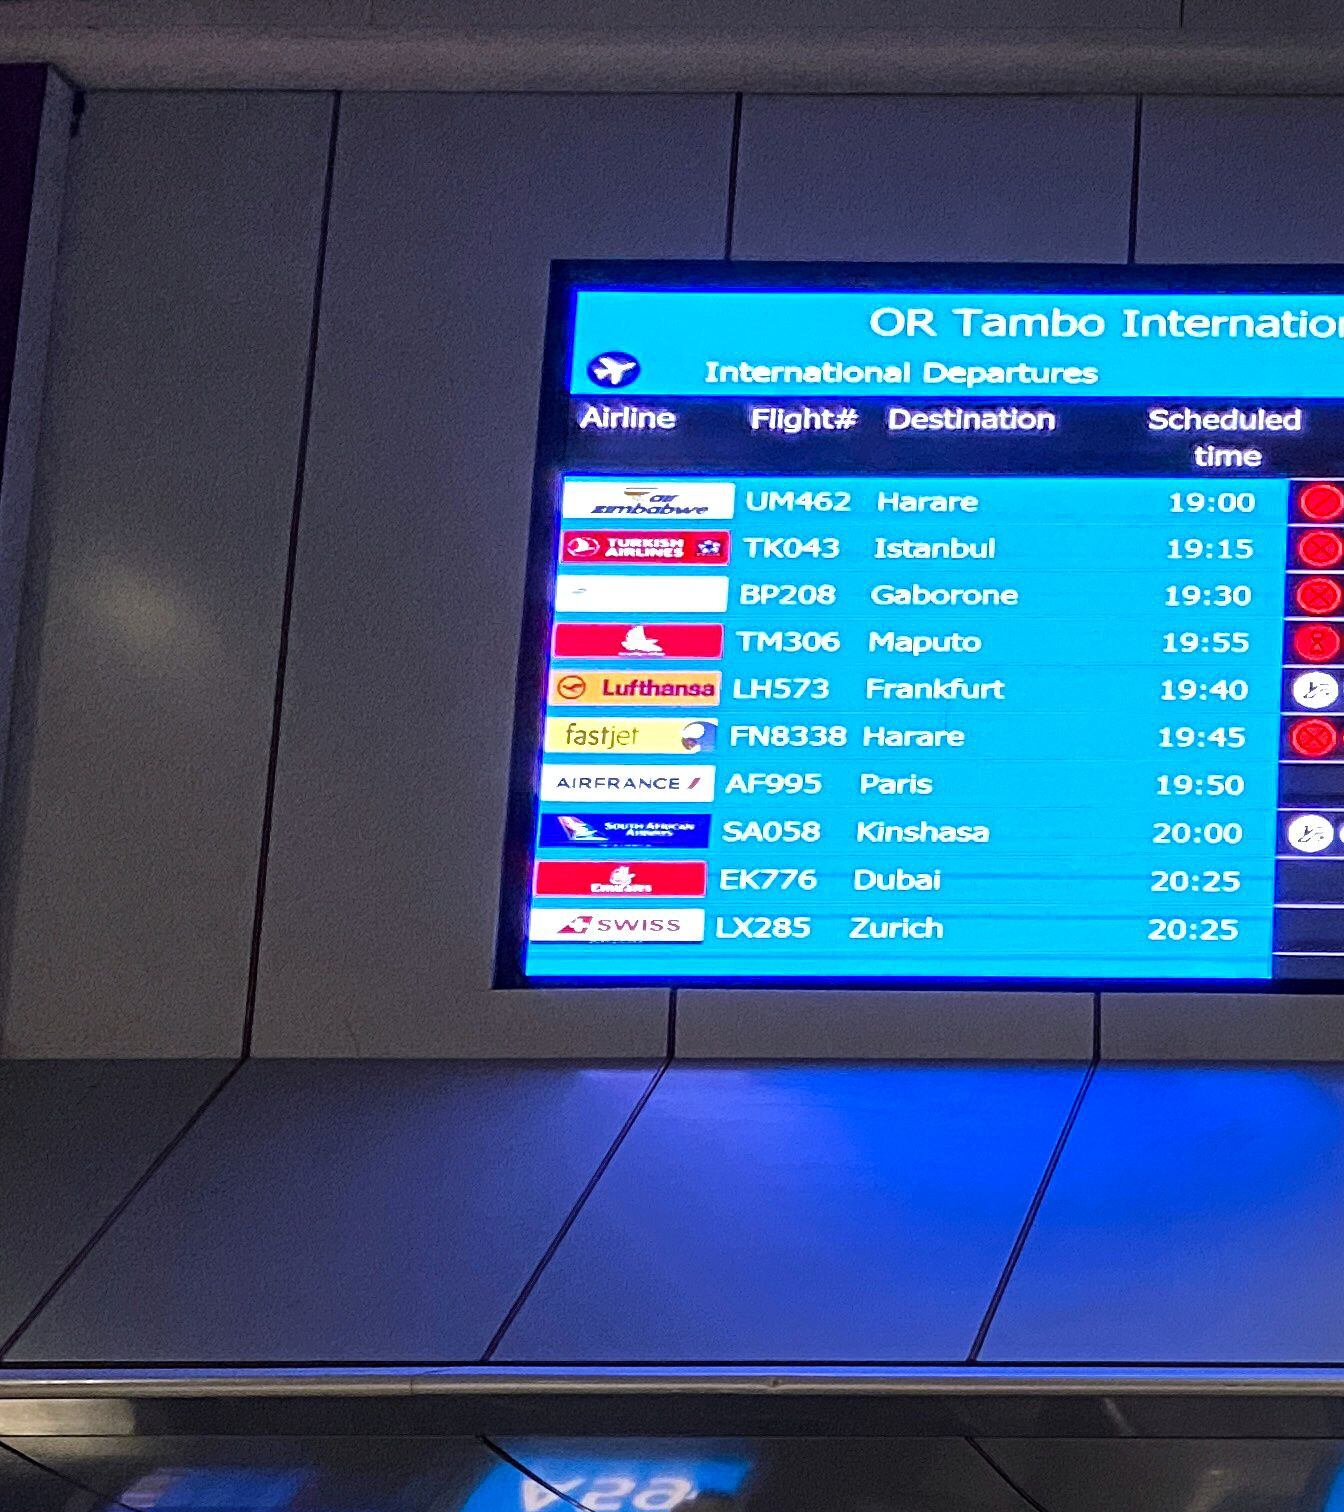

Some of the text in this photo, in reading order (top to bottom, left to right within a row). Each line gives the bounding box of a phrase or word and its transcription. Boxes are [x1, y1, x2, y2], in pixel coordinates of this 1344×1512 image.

[870, 308, 935, 336] OR
[953, 308, 1104, 336] Tambo
[706, 362, 1098, 388] International Departures
[580, 405, 676, 430] Airline
[751, 406, 859, 433] Flight#
[888, 407, 1055, 430] Destination
[1149, 407, 1302, 430] Scheduled
[1195, 445, 1262, 466] time
[747, 492, 850, 511] UM462
[878, 492, 978, 511] Harare
[1172, 493, 1255, 512] 19:00
[744, 538, 839, 558] TK043
[875, 538, 995, 558] Istanbul
[1169, 539, 1252, 558] 19:15
[741, 584, 836, 604] BP208
[871, 584, 1018, 604] Gaborone
[1167, 586, 1251, 606] 19:30
[737, 632, 840, 652] TM306
[870, 632, 981, 656] Maputo
[1164, 633, 1248, 652] 19:55
[602, 679, 715, 697] Lufthansa
[734, 678, 828, 698] LH573
[867, 678, 1004, 698] Frankfurt
[1162, 680, 1248, 700] 19:40
[566, 723, 639, 750] fastjet
[731, 726, 846, 746] FN8338
[864, 727, 964, 746] Harare
[1161, 728, 1245, 747] 19:45
[556, 774, 1244, 795] AIRFRANCE AF995 Paris 19:50
[724, 821, 820, 842] SA058
[858, 822, 989, 842] Kinshasa
[1154, 823, 1242, 844] 20:00
[720, 869, 1240, 892] EK776 Dubai 20:25
[598, 917, 1238, 940] SWISS LX285 Zurich 20:25
